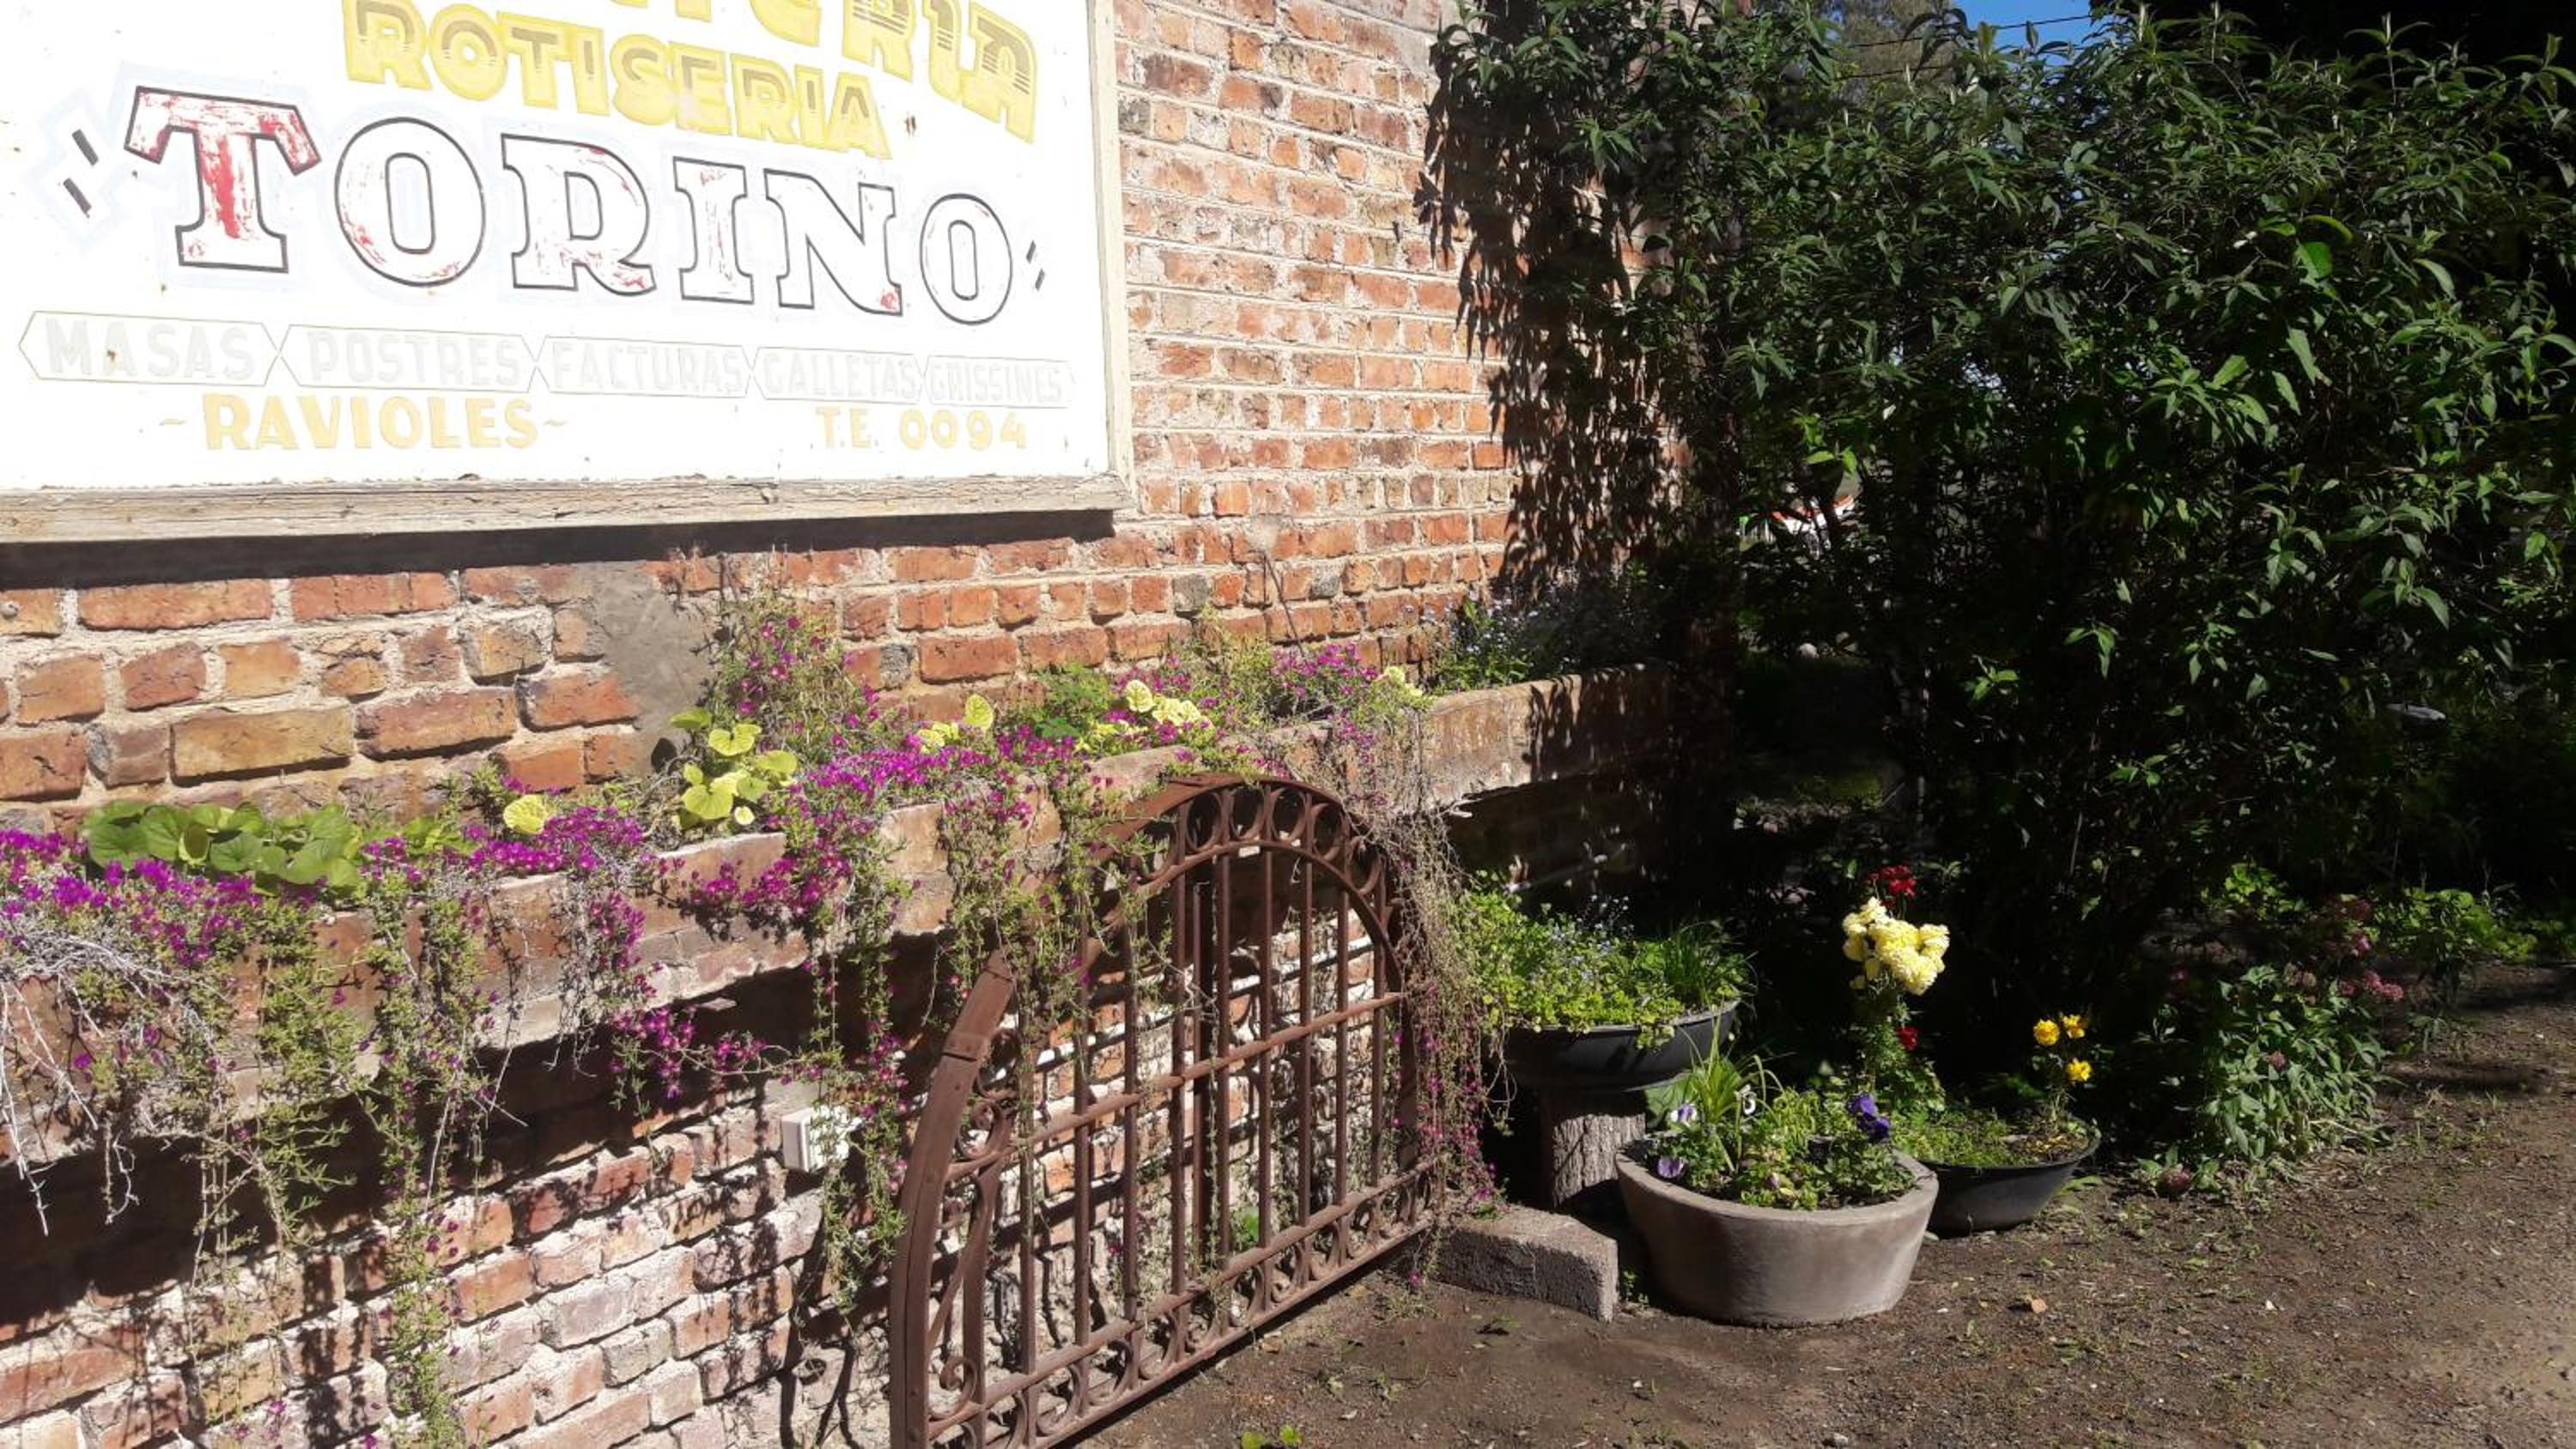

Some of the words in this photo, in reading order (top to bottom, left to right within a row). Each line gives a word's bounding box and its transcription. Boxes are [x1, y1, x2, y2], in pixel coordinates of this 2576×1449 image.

[341, 0, 893, 161] ROTISERIA
[45, 318, 257, 381] MASAS
[307, 330, 520, 387] POSTRES
[552, 342, 744, 397] FACTURAS
[927, 361, 1064, 404] GRISSINES
[201, 392, 539, 451] RAVIOLES
[899, 408, 1028, 451] 0094
